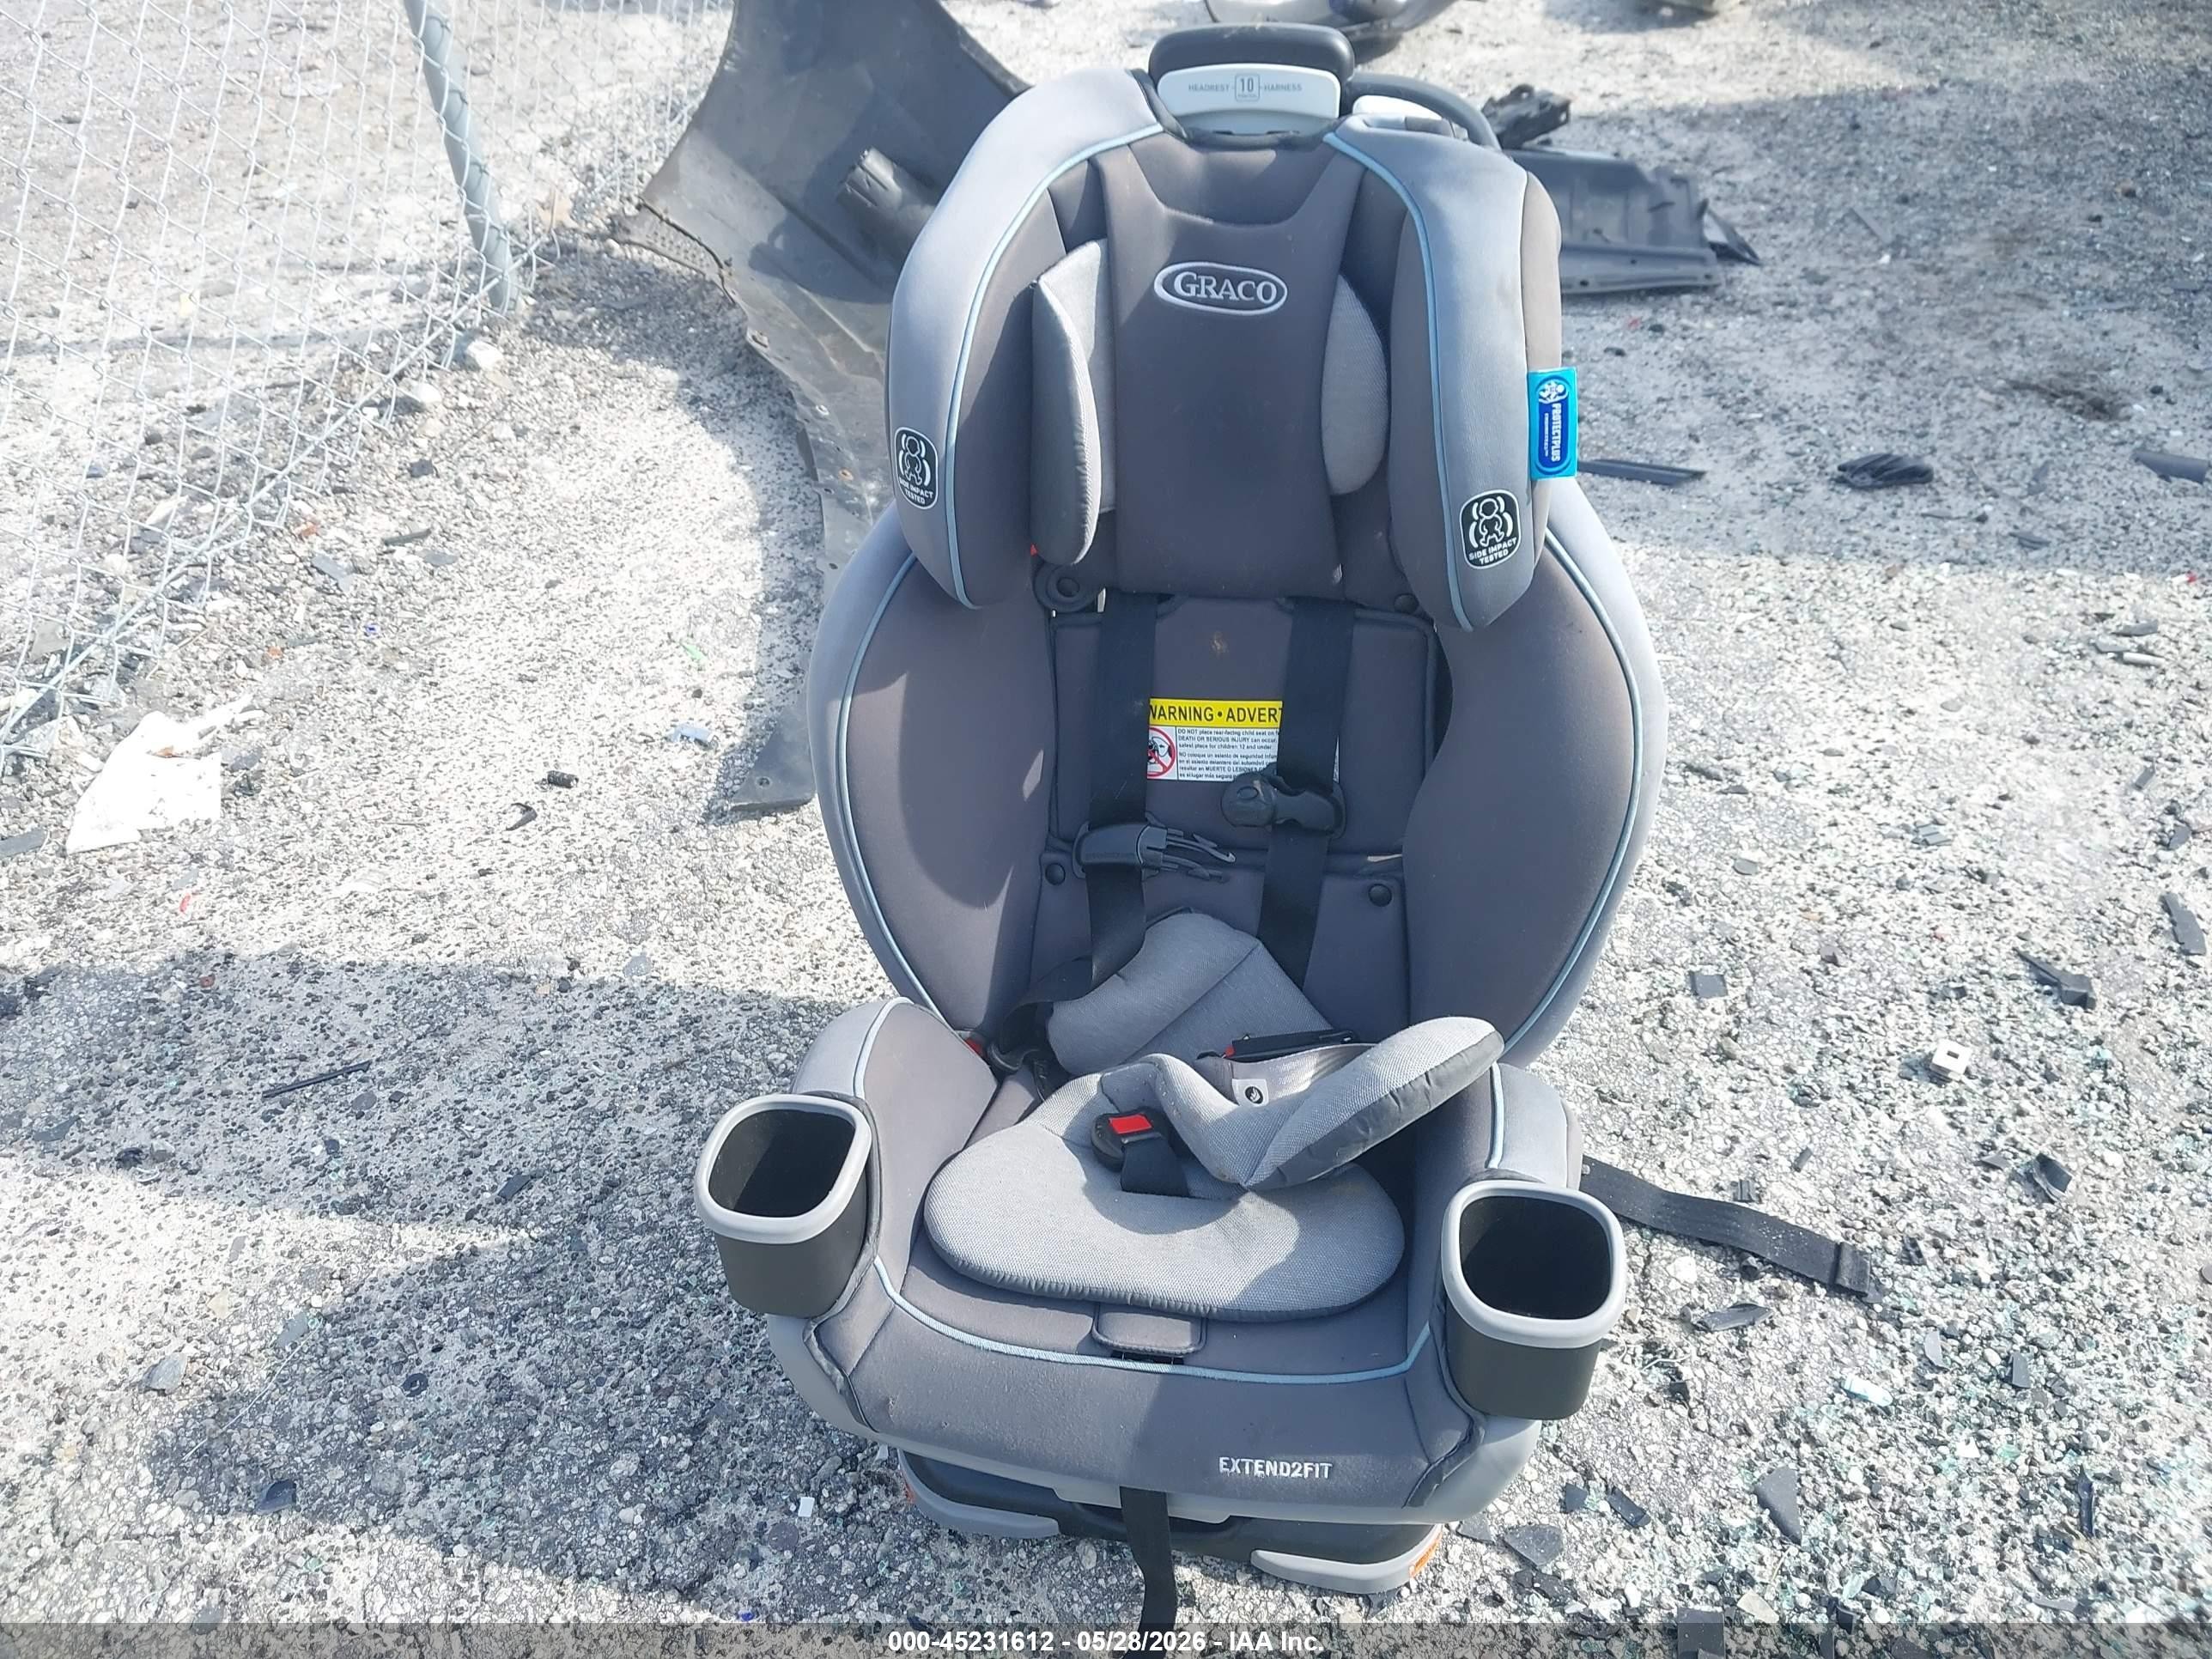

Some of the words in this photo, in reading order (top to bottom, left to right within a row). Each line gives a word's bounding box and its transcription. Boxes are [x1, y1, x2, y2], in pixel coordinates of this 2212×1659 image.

[1188, 83, 1231, 92] HEADREST
[1240, 77, 1254, 93] 10
[1264, 83, 1303, 92] HARNESS
[1174, 271, 1277, 304] GRACO
[905, 489, 925, 504] TESTED
[910, 483, 933, 498] IMPACT
[1469, 548, 1487, 560] SIDE
[1488, 538, 1517, 554] IMPACT
[1480, 549, 1509, 564] TESTED
[1218, 1456, 1333, 1479] EXTEND2FIT
